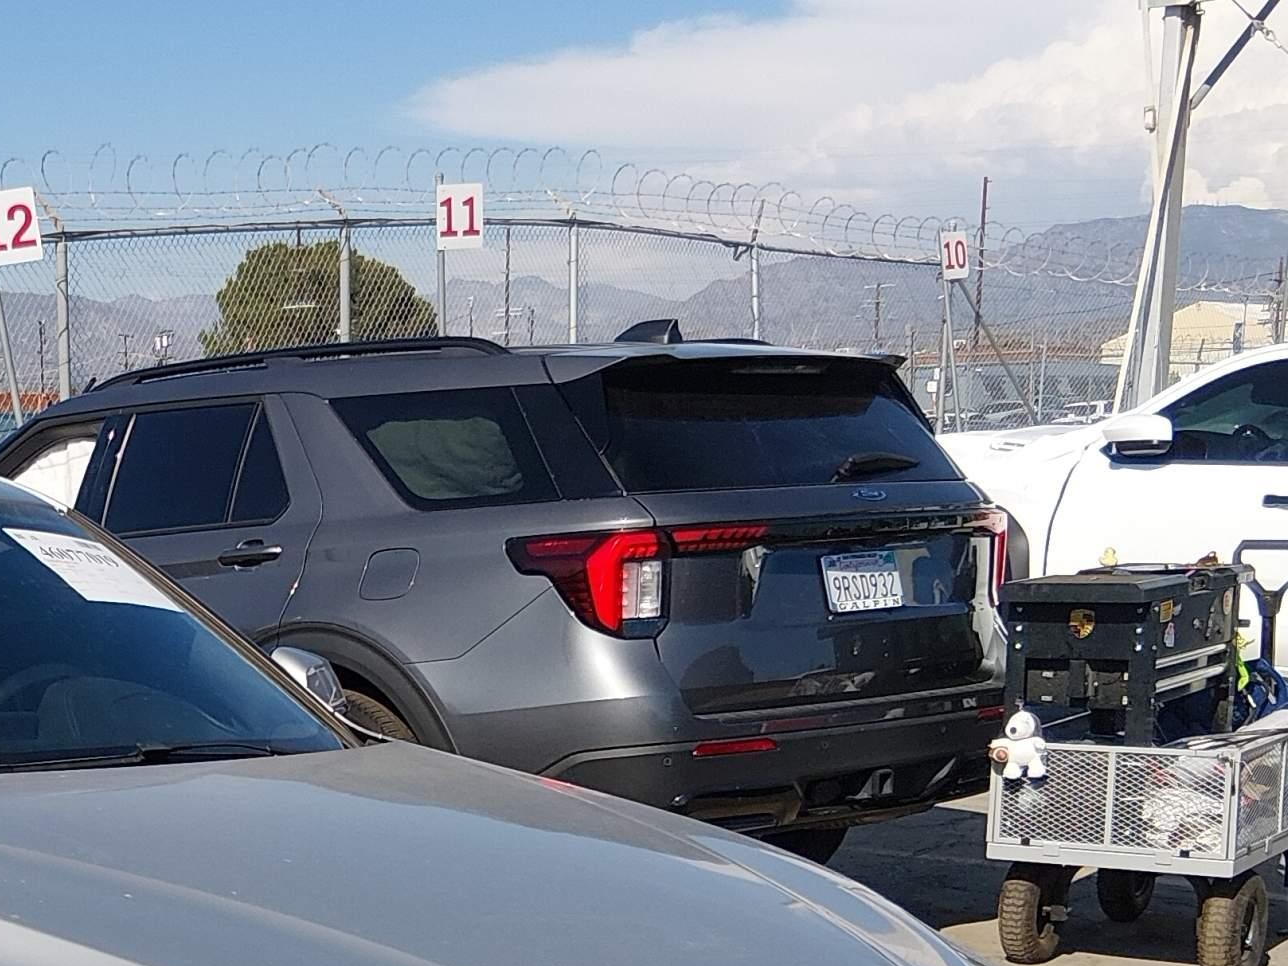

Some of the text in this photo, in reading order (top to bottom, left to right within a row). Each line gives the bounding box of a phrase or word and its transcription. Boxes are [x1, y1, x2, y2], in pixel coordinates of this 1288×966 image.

[439, 195, 481, 238] 11
[943, 240, 967, 270] 10
[832, 571, 899, 603] 9RSD932
[838, 597, 901, 611] GALPIN
